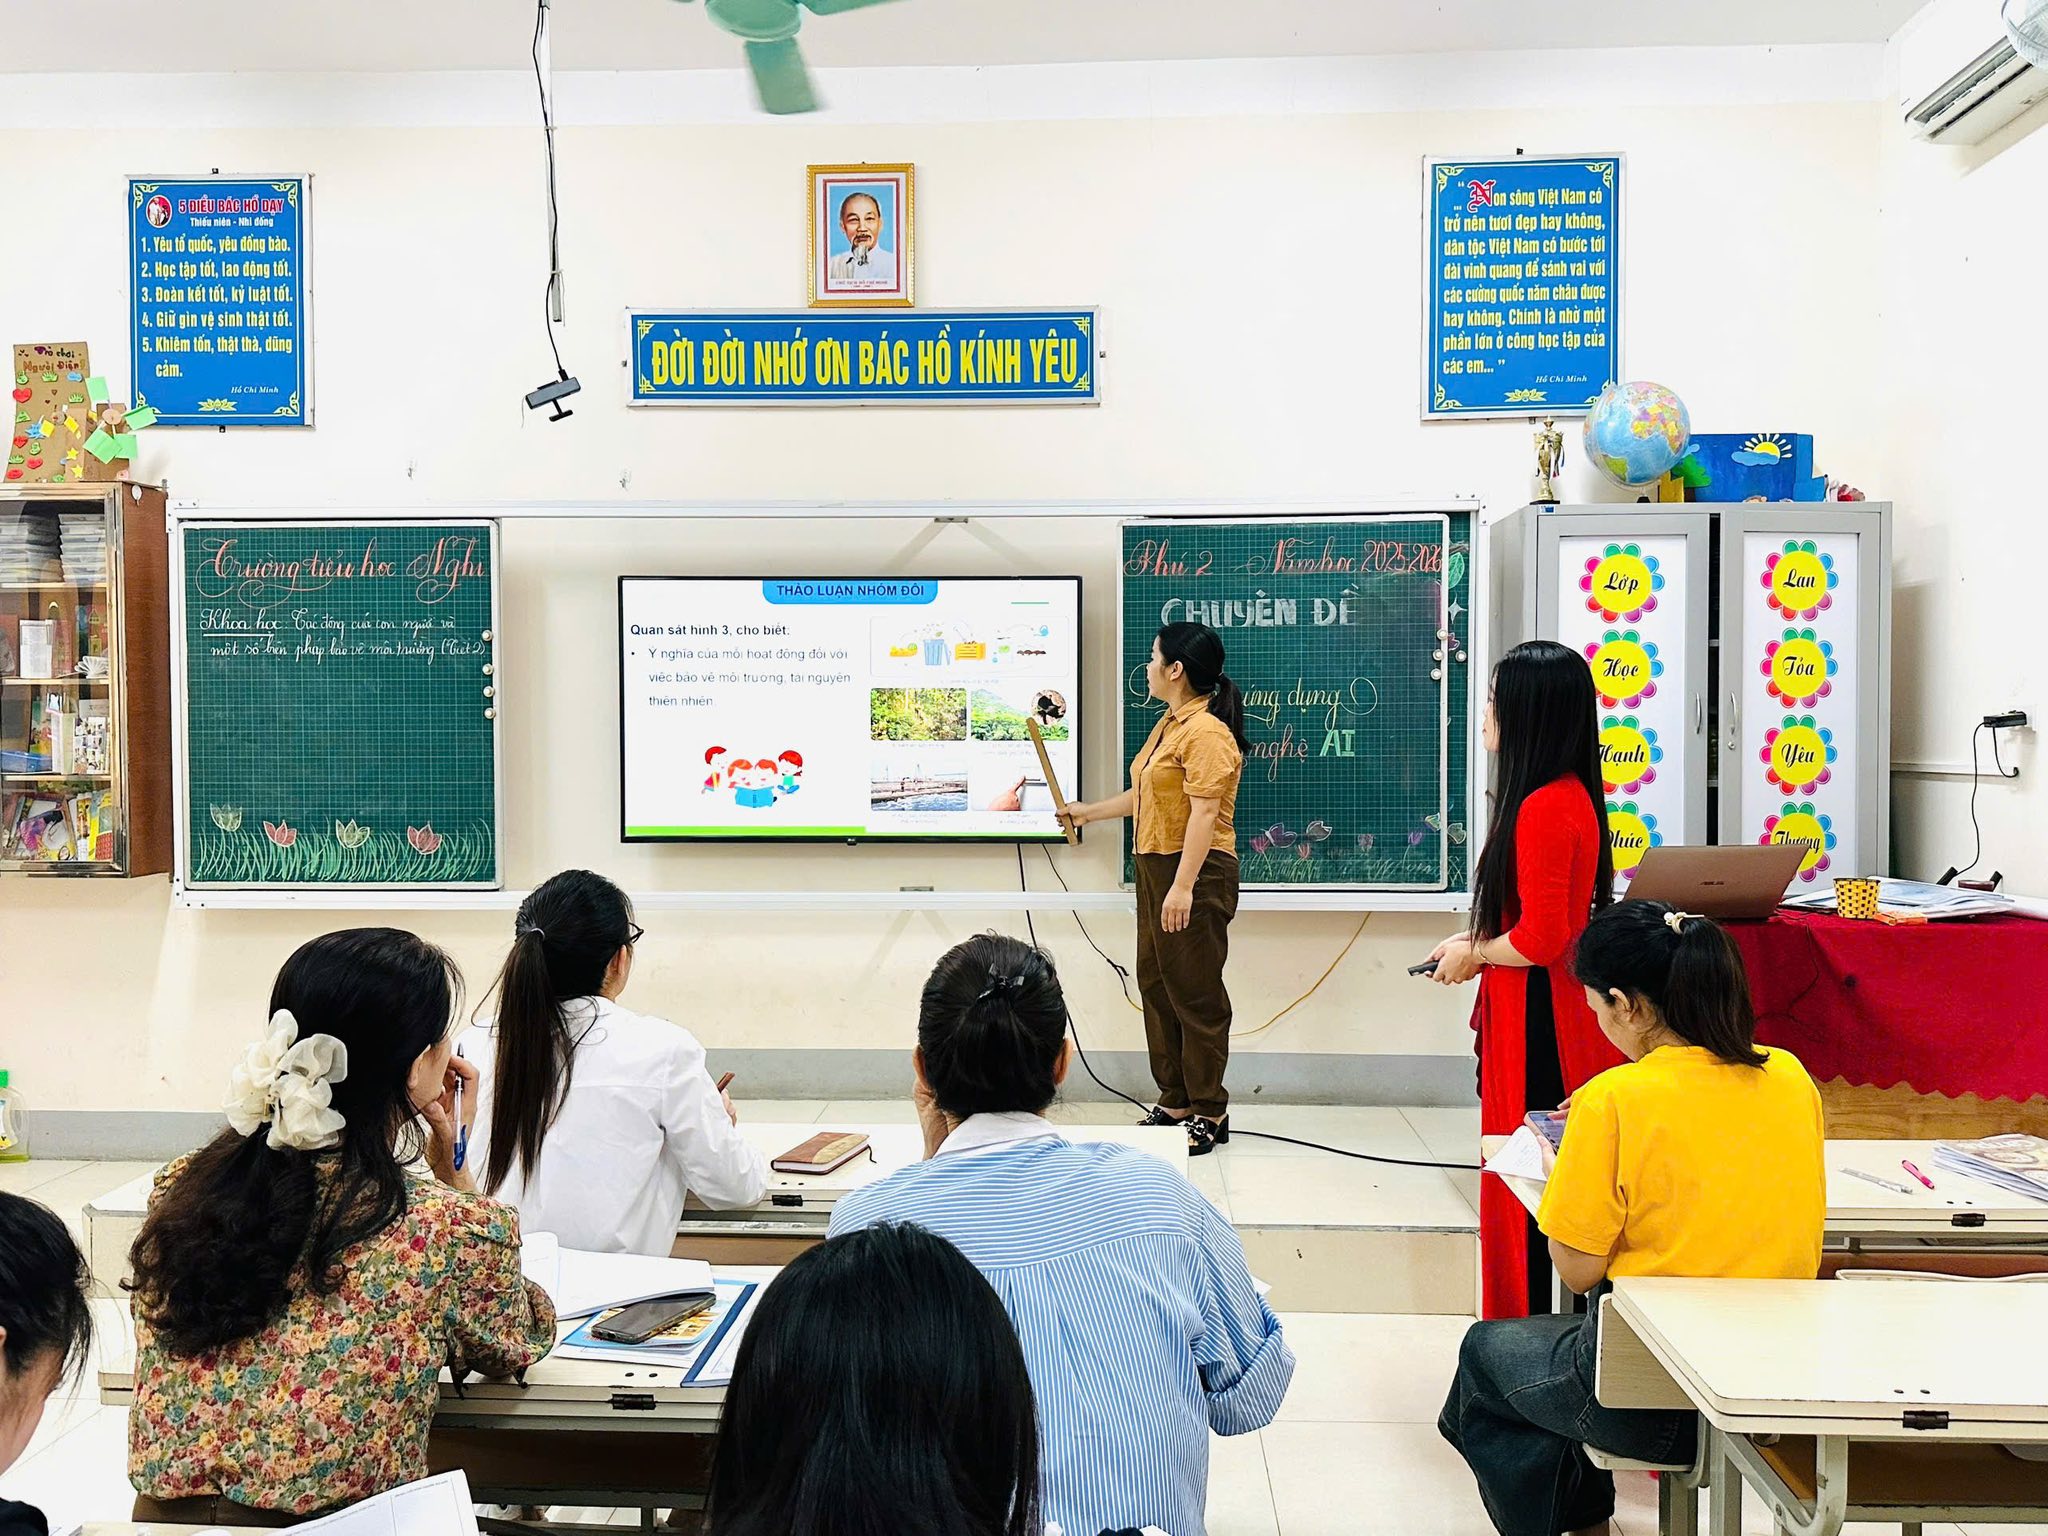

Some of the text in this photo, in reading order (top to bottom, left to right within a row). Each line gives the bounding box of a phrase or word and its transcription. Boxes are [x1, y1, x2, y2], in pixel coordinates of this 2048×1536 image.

[178, 194, 284, 216] 5 ĐIỀU BÁC HỒ DẠY
[1509, 188, 1536, 208] sông
[1537, 188, 1559, 209] Việt
[1561, 187, 1587, 205] Nam
[1588, 187, 1603, 205] có
[190, 215, 212, 227] Thiếu
[213, 216, 232, 227] niên
[1443, 211, 1606, 234] trở nên tươi đẹp hay không,
[141, 233, 291, 255] 1. Yêu tổ quốc, yêu đồng bào.
[1443, 235, 1606, 259] dân tộc Việt Nam có bước tới
[141, 258, 292, 281] 2. Học tập tốt, lao động tốt.
[1443, 258, 1606, 281] đài vinh quang để sánh vai với
[141, 283, 293, 305] 3. Đoàn kết tốt, kỷ luật tốt.
[1443, 283, 1606, 305] các cường quốc năm châu được
[141, 308, 293, 331] 4. Giữ gìn vệ sinh thật tốt.
[1443, 306, 1606, 329] hay không. Chính là nhờ một
[142, 334, 293, 356] 5. Khiêm tốn, thật thà, dũng
[1443, 328, 1606, 353] phần lớn ở công học tập của
[651, 324, 1077, 386] ĐỜI ĐỜI NHỚ ƠN BÁC HỒ KÍNH YÊU
[1442, 357, 1464, 375] các
[155, 359, 183, 378] cảm.
[1565, 375, 1588, 383] Minh
[258, 386, 279, 394] Minh
[1123, 538, 1213, 577] Phú 2
[1238, 537, 1318, 575] Năm
[405, 535, 486, 604] Nghi
[1783, 568, 1815, 588] Lan
[776, 583, 924, 596] THẢO NHÓM ĐÔI
[1603, 571, 1640, 595] Lớp
[199, 607, 456, 631] Khoa Tác con và
[1161, 589, 1297, 628] CHUYÊN
[630, 624, 664, 635] Quan
[667, 625, 687, 635] sát
[722, 625, 732, 637] 3,
[736, 625, 760, 635] cho
[210, 641, 240, 660] một
[244, 638, 264, 655] số
[294, 633, 325, 665] pháp
[1603, 657, 1640, 681] Học
[1783, 655, 1815, 676] Tỏa
[1287, 677, 1350, 733] dụng
[1319, 729, 1356, 757] AI
[1599, 743, 1646, 767] Hạnh
[1781, 743, 1815, 768] Yêu
